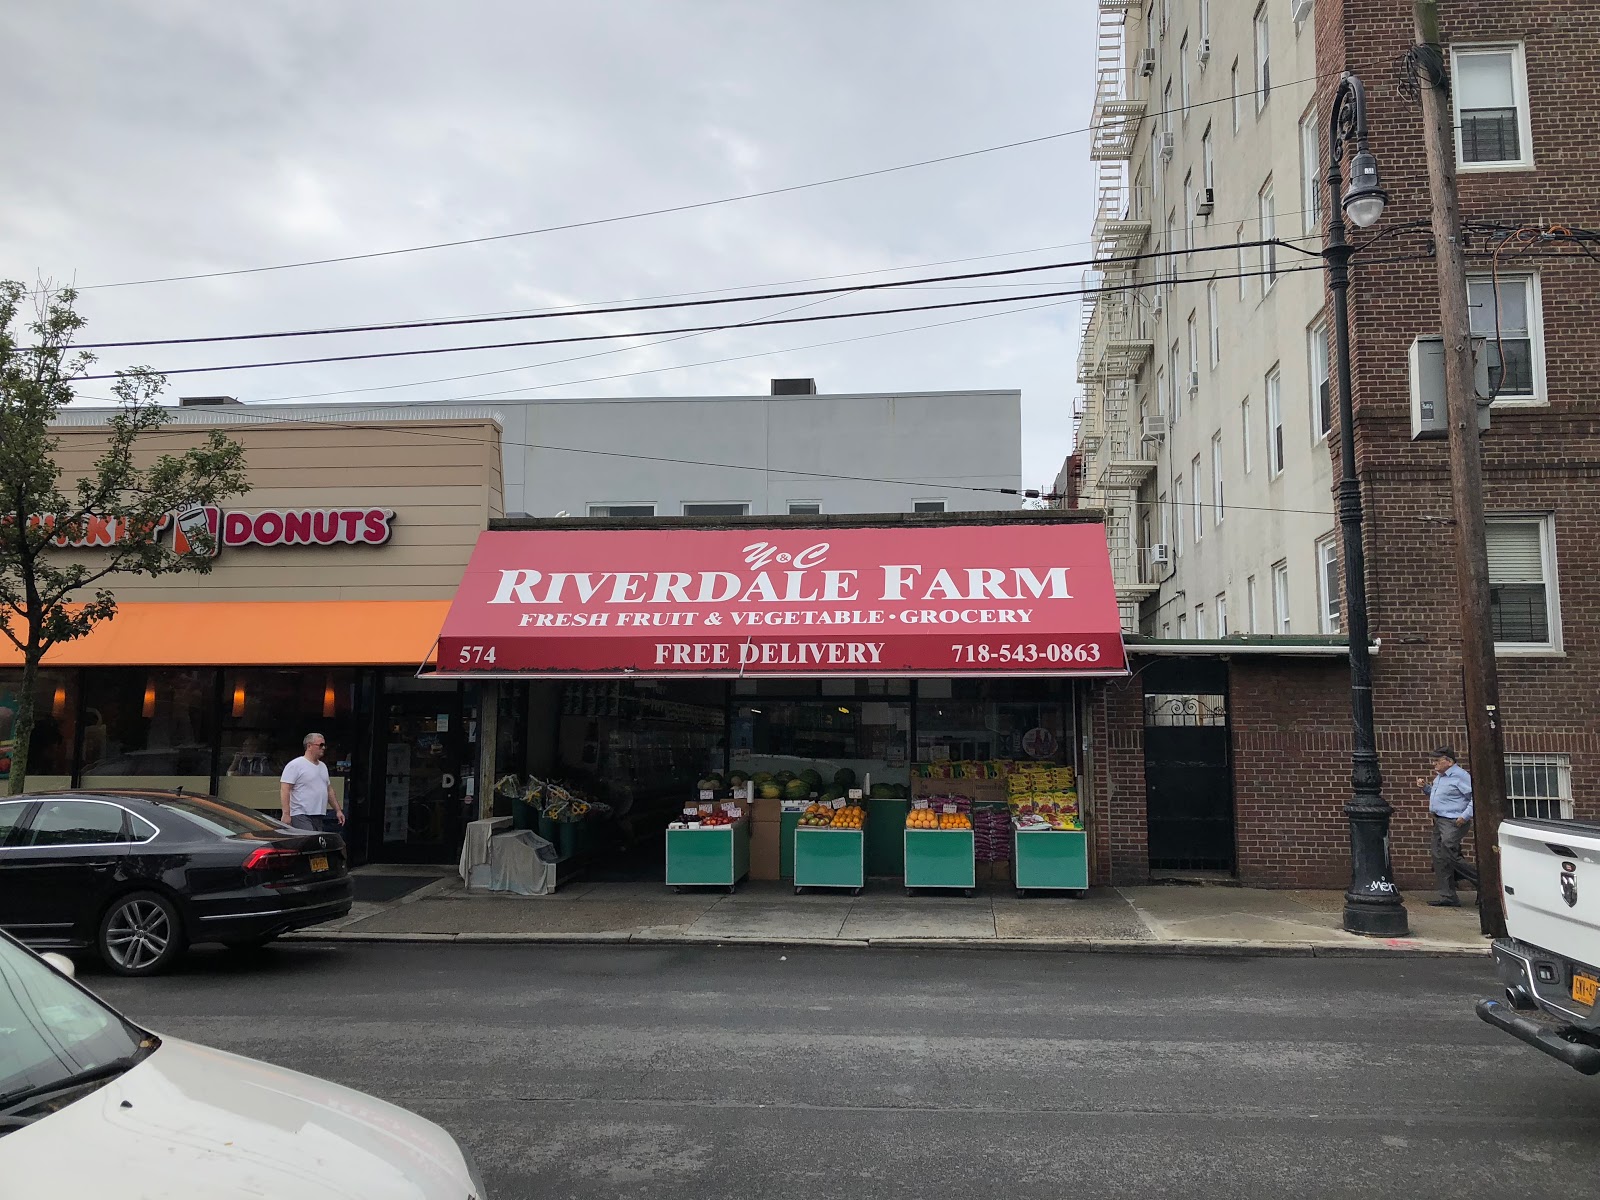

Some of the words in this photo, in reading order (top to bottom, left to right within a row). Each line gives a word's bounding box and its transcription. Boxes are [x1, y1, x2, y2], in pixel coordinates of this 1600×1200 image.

[225, 509, 385, 544] DONUTS
[487, 568, 859, 604] RIVERDALE
[878, 564, 1074, 600] FARM
[518, 613, 610, 627] FRESH
[616, 612, 699, 626] FRUIT
[703, 612, 723, 626] &
[731, 610, 885, 625] VEGETABLE
[900, 609, 1033, 623] GROCERY
[459, 646, 497, 664] 574
[654, 643, 730, 664] FREE
[738, 642, 885, 664] DELIVERY
[951, 643, 1101, 663] 718-543-0863
